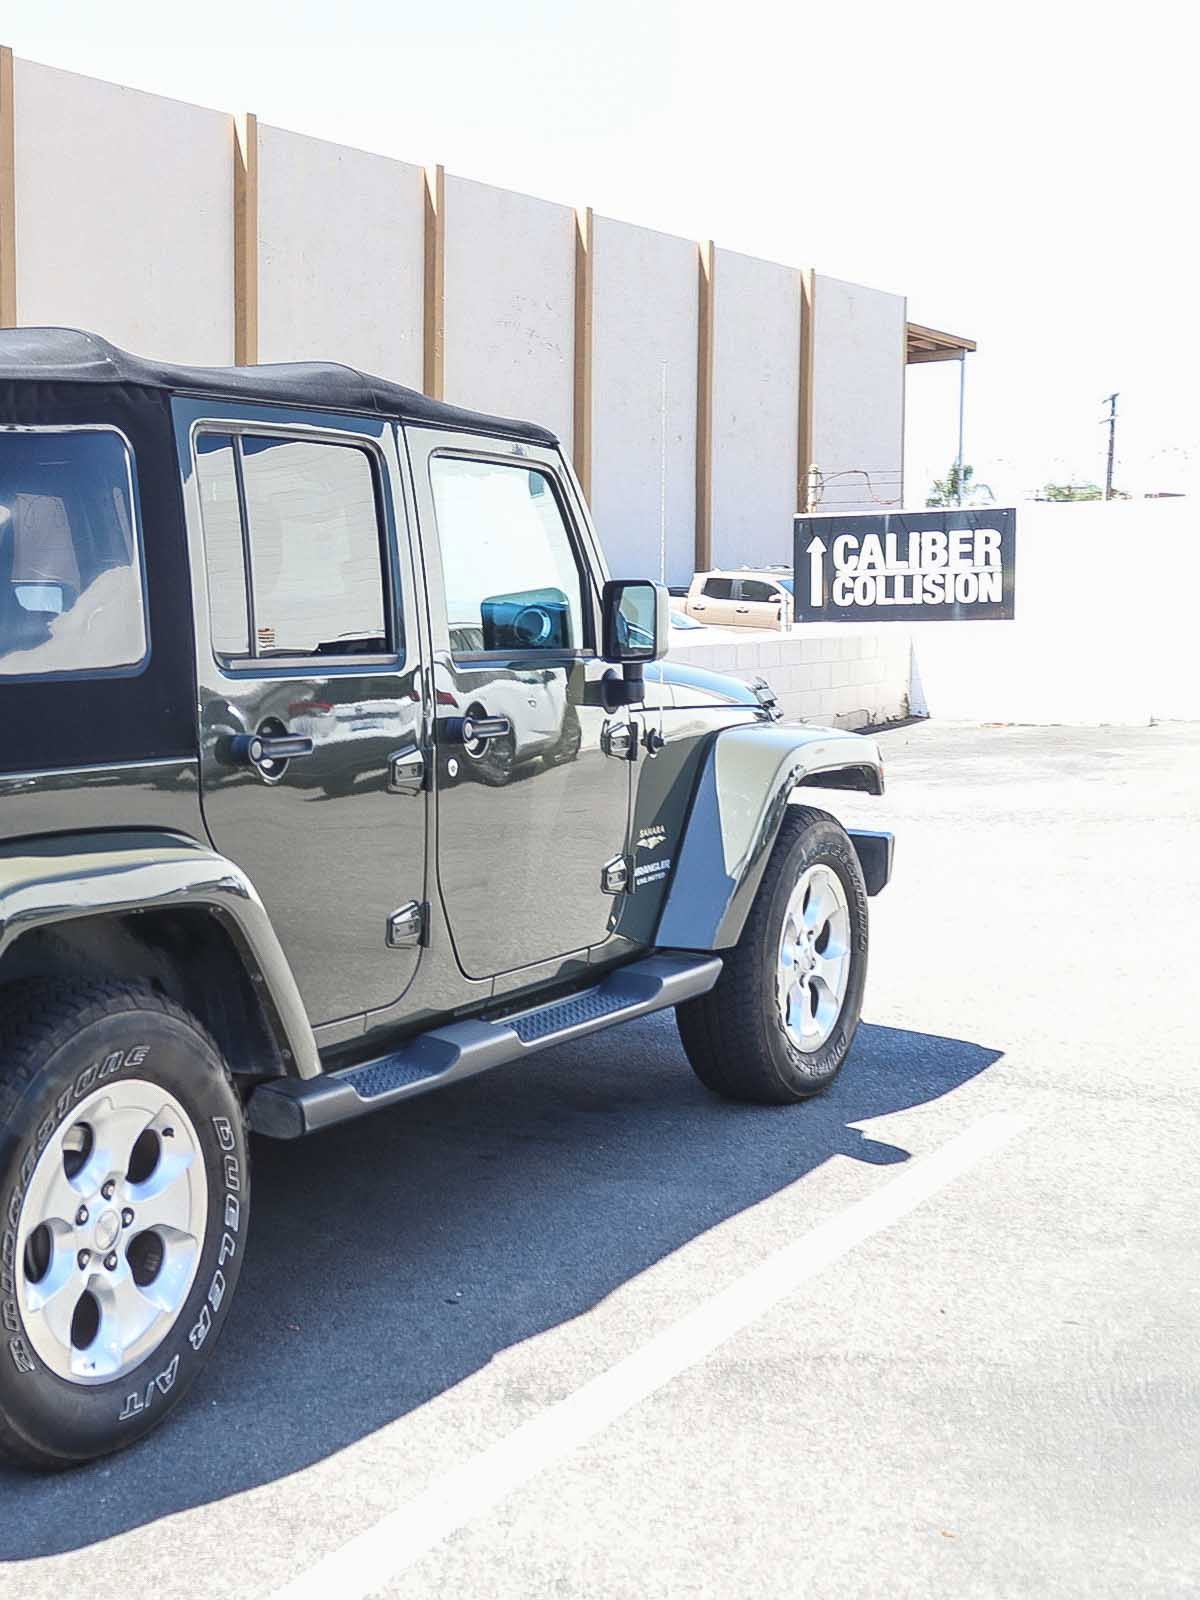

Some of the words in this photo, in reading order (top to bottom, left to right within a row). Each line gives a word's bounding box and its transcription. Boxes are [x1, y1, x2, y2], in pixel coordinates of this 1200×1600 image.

[833, 529, 1002, 571] CALIBER
[833, 571, 1003, 607] COLLISION
[634, 859, 671, 877] WRANGLER
[0, 1044, 151, 1374] BRIDGESTONE
[188, 1115, 242, 1351] DUELER
[118, 1353, 180, 1421] A/T
